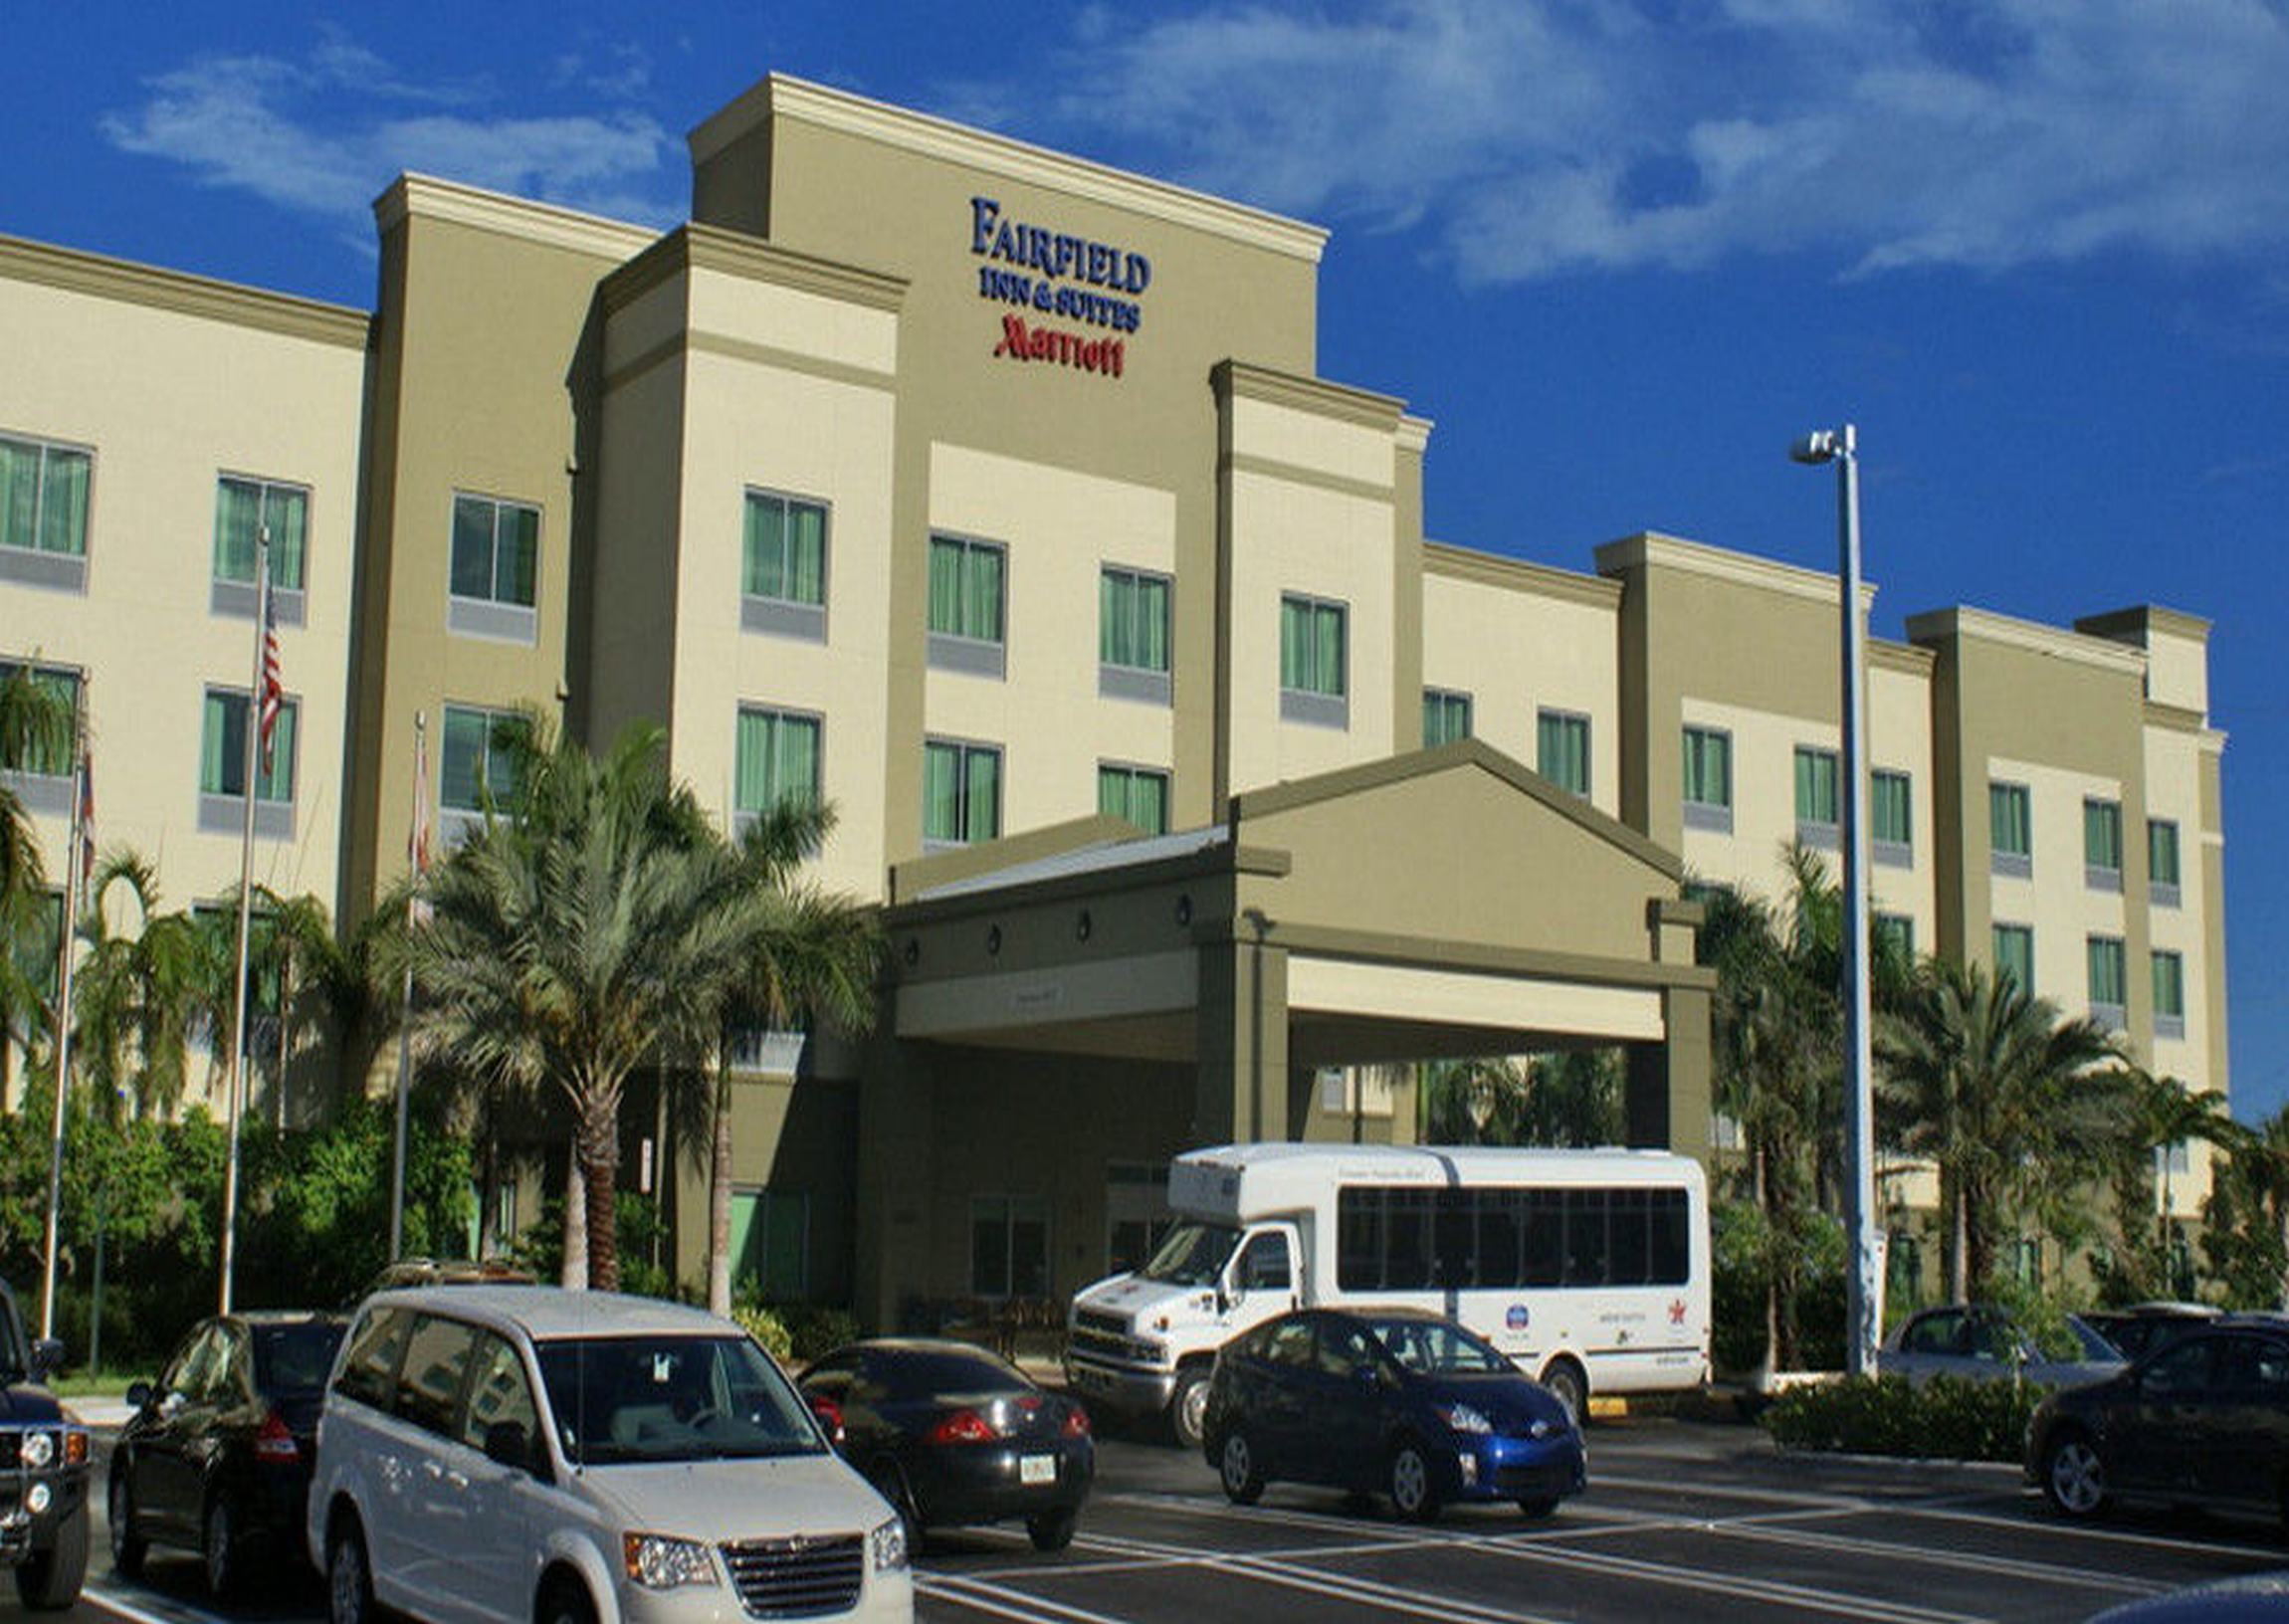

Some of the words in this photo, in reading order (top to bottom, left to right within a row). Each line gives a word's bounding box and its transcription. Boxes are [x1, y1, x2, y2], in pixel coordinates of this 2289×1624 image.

[970, 196, 1152, 295] FAIRFIELD
[978, 266, 1032, 307] INN
[1033, 280, 1053, 313] &
[1055, 285, 1142, 334] SUITES
[993, 311, 1126, 379] Marriott
